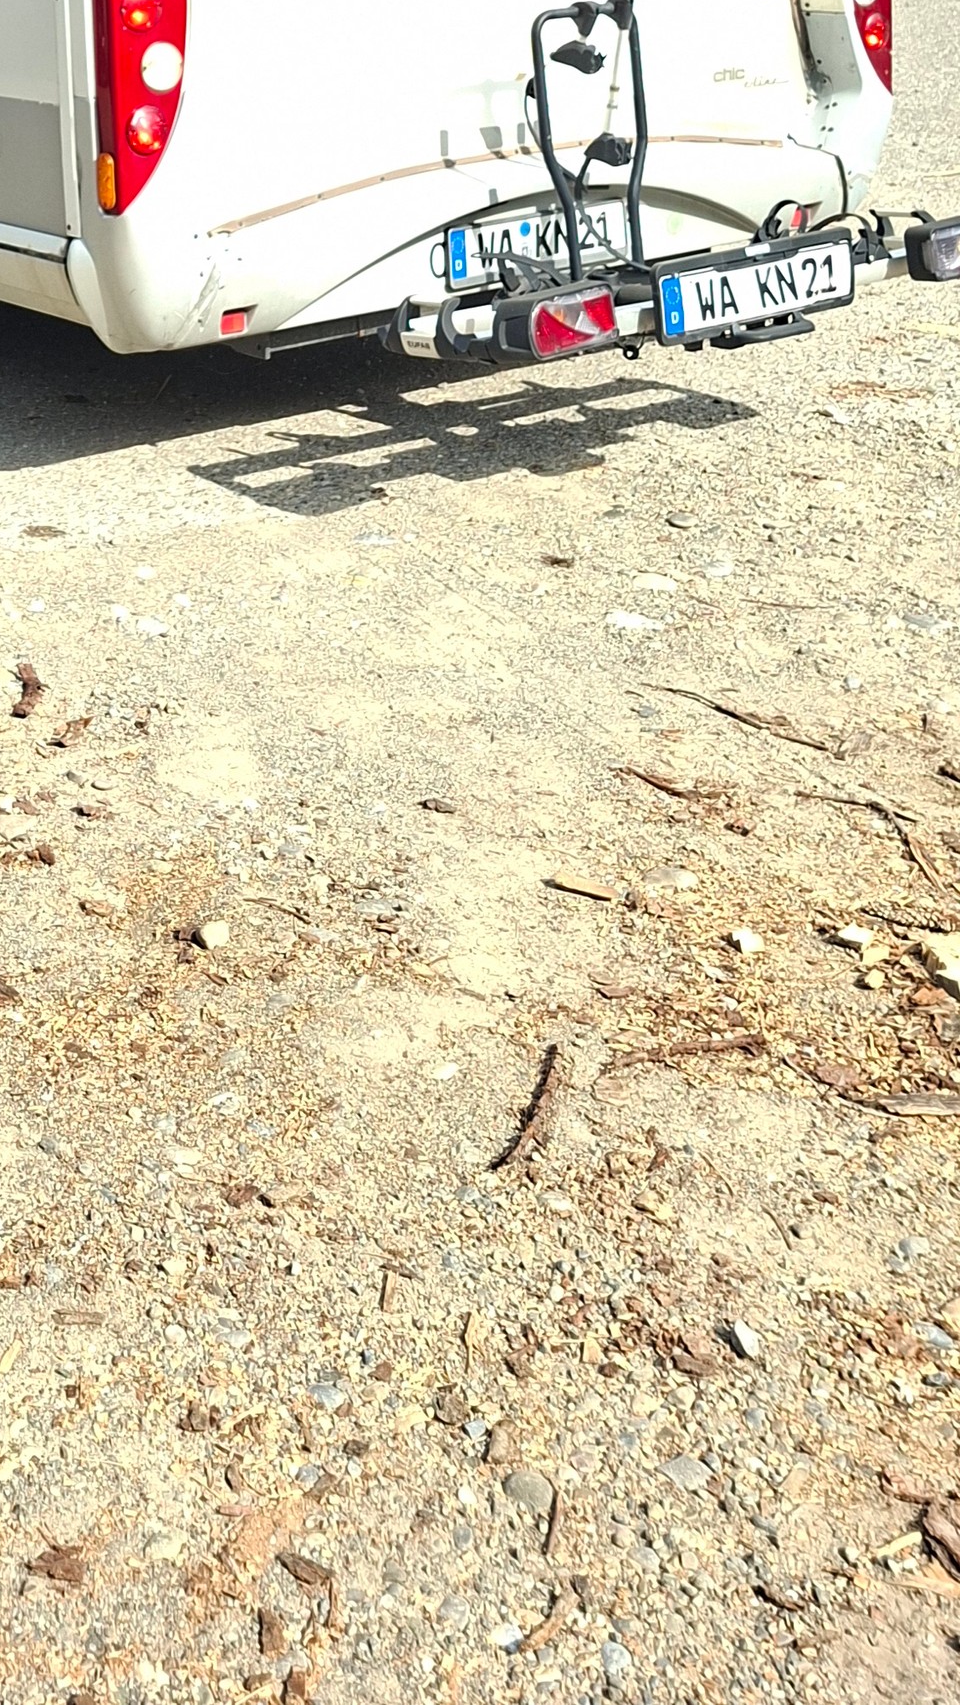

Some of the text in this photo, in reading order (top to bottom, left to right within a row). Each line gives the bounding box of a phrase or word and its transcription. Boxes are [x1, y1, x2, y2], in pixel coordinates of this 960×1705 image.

[713, 67, 745, 83] chic
[478, 229, 513, 269] WA
[670, 311, 680, 325] D
[695, 276, 739, 321] WA
